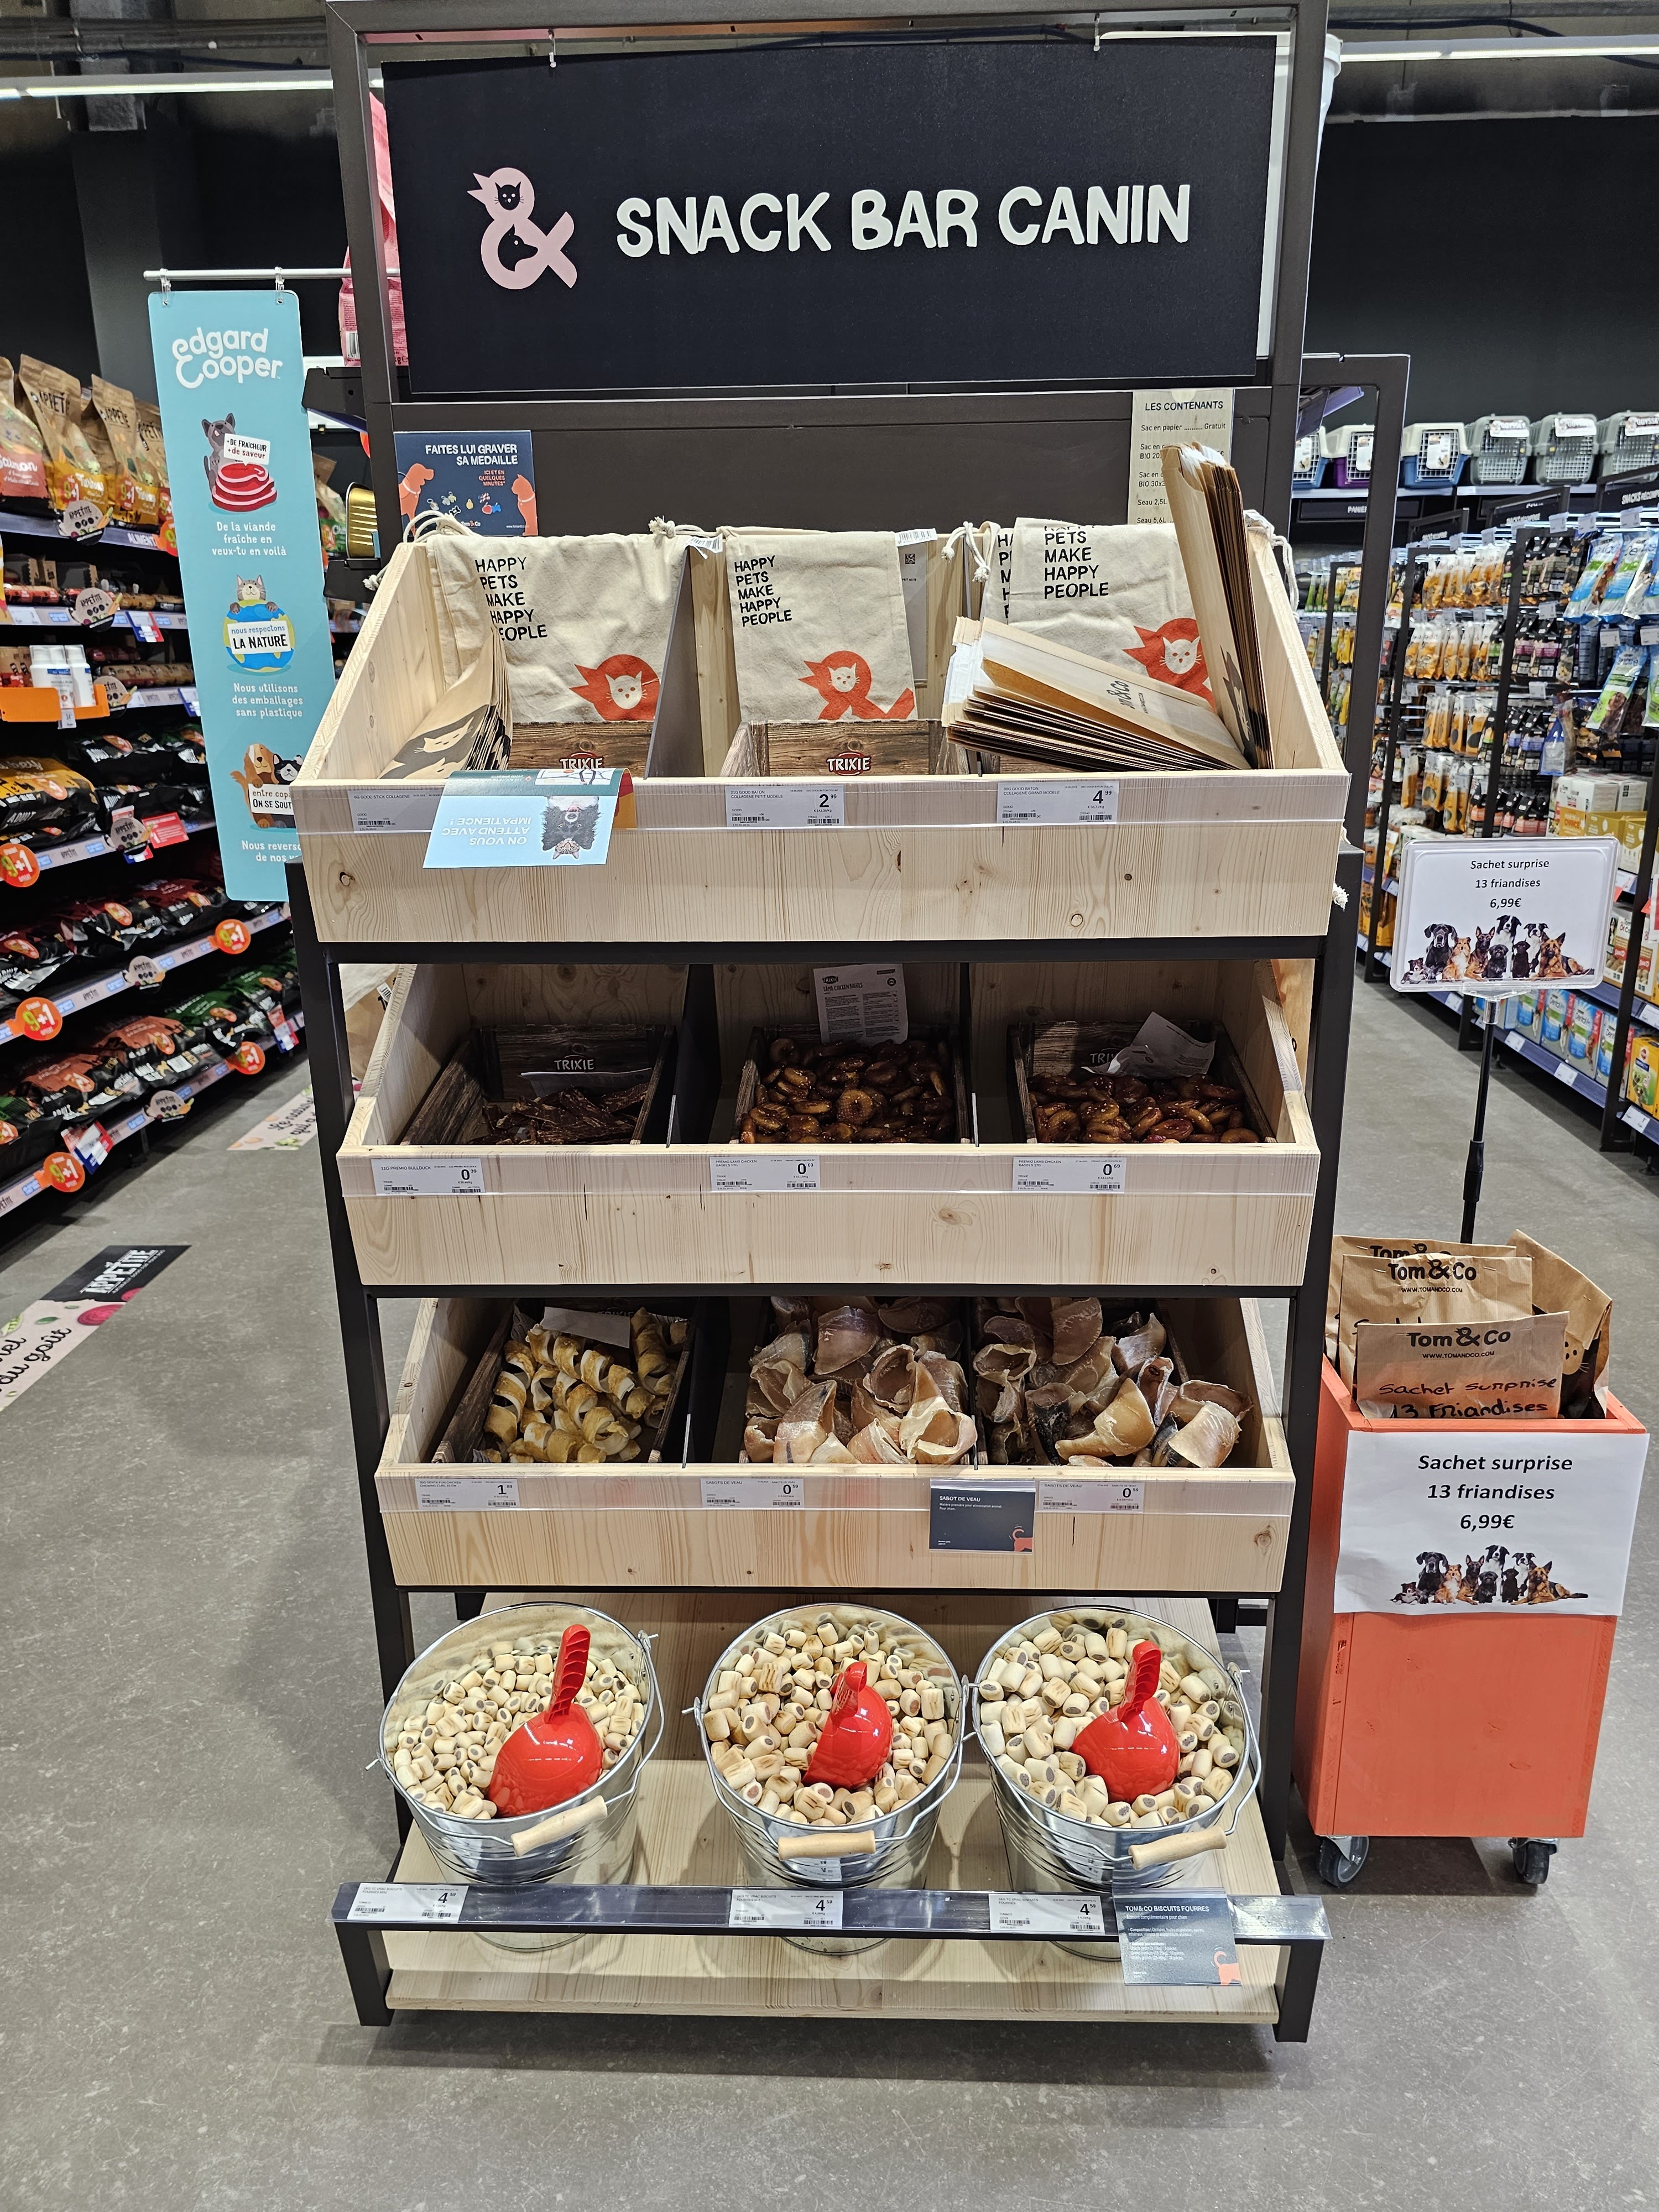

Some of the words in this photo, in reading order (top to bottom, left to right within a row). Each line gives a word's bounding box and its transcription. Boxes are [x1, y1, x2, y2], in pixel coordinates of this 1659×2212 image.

[617, 192, 831, 258] SNACK
[851, 189, 978, 252] BAR
[998, 184, 1190, 246] CANIN
[172, 327, 269, 358] edgard
[176, 355, 283, 389] Cooper
[1145, 403, 1161, 411] LES
[1164, 401, 1223, 410] CONTENANTS
[242, 450, 265, 459] saveur
[425, 445, 458, 455] FAITES
[460, 445, 476, 454] LUI
[477, 444, 517, 453] GRAVER
[456, 456, 469, 466] SA
[471, 455, 518, 465] MEDAILLE
[217, 522, 228, 531] De
[231, 523, 240, 531] la
[243, 523, 276, 531] viande
[224, 534, 258, 544] fraîche
[1045, 531, 1087, 545] PETS
[212, 546, 247, 556] veux-tu
[249, 547, 260, 555] en
[262, 545, 286, 556] voilà
[1045, 547, 1092, 564] MAKE
[475, 557, 527, 572] HAPPY
[734, 555, 775, 573] HAPPY
[736, 571, 769, 586] PETS
[1045, 566, 1099, 582] HAPPY
[479, 575, 518, 590] PETS
[738, 585, 774, 600] MAKE
[1045, 583, 1109, 599] PEOPLE
[486, 592, 525, 607] MAKE
[739, 597, 781, 613] HAPPY
[491, 609, 534, 624] HAPPY
[742, 610, 792, 627] PEOPLE
[231, 626, 247, 634] nous
[249, 624, 285, 634] respectons
[499, 624, 548, 641] EOPLE
[233, 637, 246, 650] LA
[248, 634, 288, 648] NATURE
[233, 683, 256, 693] Nous
[258, 682, 298, 693] utilisons
[232, 695, 248, 705] des
[250, 695, 303, 707] emballages
[236, 708, 258, 717] sans
[260, 707, 303, 719] plastique
[560, 758, 603, 769] TRIXIE
[827, 757, 871, 771] TRIXIE
[253, 799, 263, 807] ON
[819, 794, 830, 808] 2
[1093, 790, 1104, 804] 4
[458, 817, 531, 826] IMPATIENCE
[442, 827, 477, 836] AVEC
[479, 827, 530, 835] ATTEND
[242, 840, 265, 850] Nous
[469, 837, 504, 845] VOUS
[256, 852, 267, 861] de
[1470, 860, 1505, 869] Sachet
[1507, 859, 1549, 871] surprise
[1475, 880, 1487, 888] 13
[1491, 878, 1541, 888] friandises
[1490, 898, 1521, 909] 6,99€
[1090, 1053, 1115, 1063] TRI
[554, 1059, 594, 1070] TRIXIE
[461, 1169, 470, 1180] 0
[797, 1163, 806, 1175] 0
[1103, 1164, 1112, 1175] 0
[24, 1328, 72, 1361] goût
[1379, 1383, 1454, 1396] Sachet
[1465, 1378, 1557, 1392] surprise
[1390, 1404, 1418, 1418] 13
[1429, 1399, 1547, 1418] Friandises
[1418, 1455, 1486, 1470] Sachet
[1491, 1455, 1572, 1473] surprise
[498, 1485, 507, 1495] 1
[783, 1484, 791, 1494] 0
[1123, 1488, 1131, 1498] 0
[1427, 1484, 1451, 1499] 13
[1457, 1484, 1555, 1500] friandises
[1460, 1514, 1515, 1532] 6,99€
[438, 1892, 448, 1903] 4
[816, 1900, 825, 1911] 4
[1080, 1903, 1089, 1916] 4
